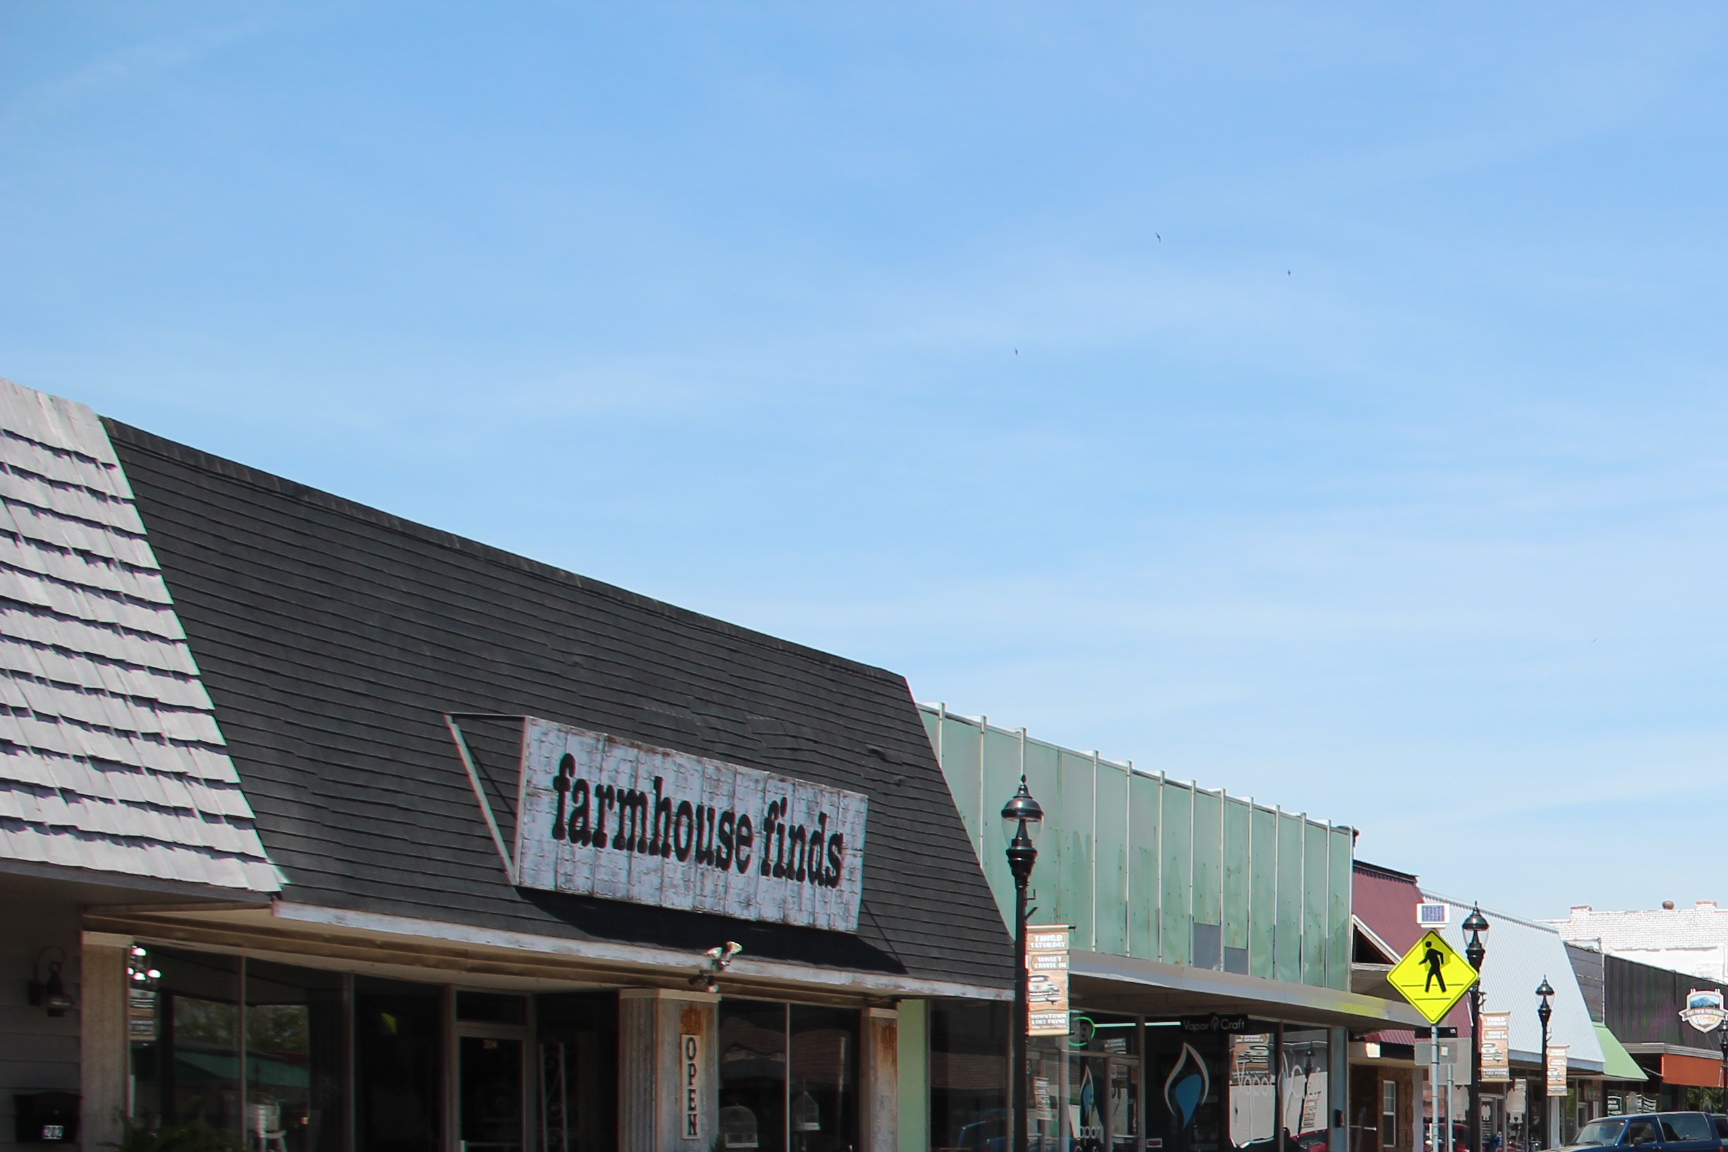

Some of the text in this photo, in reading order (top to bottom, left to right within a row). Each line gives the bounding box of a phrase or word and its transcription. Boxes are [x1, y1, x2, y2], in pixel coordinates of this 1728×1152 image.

[553, 752, 844, 888] farmhouse finds
[1034, 934, 1063, 942] THIRD
[1183, 1019, 1245, 1032] Vapor Craft
[686, 1037, 697, 1136] OPEN
